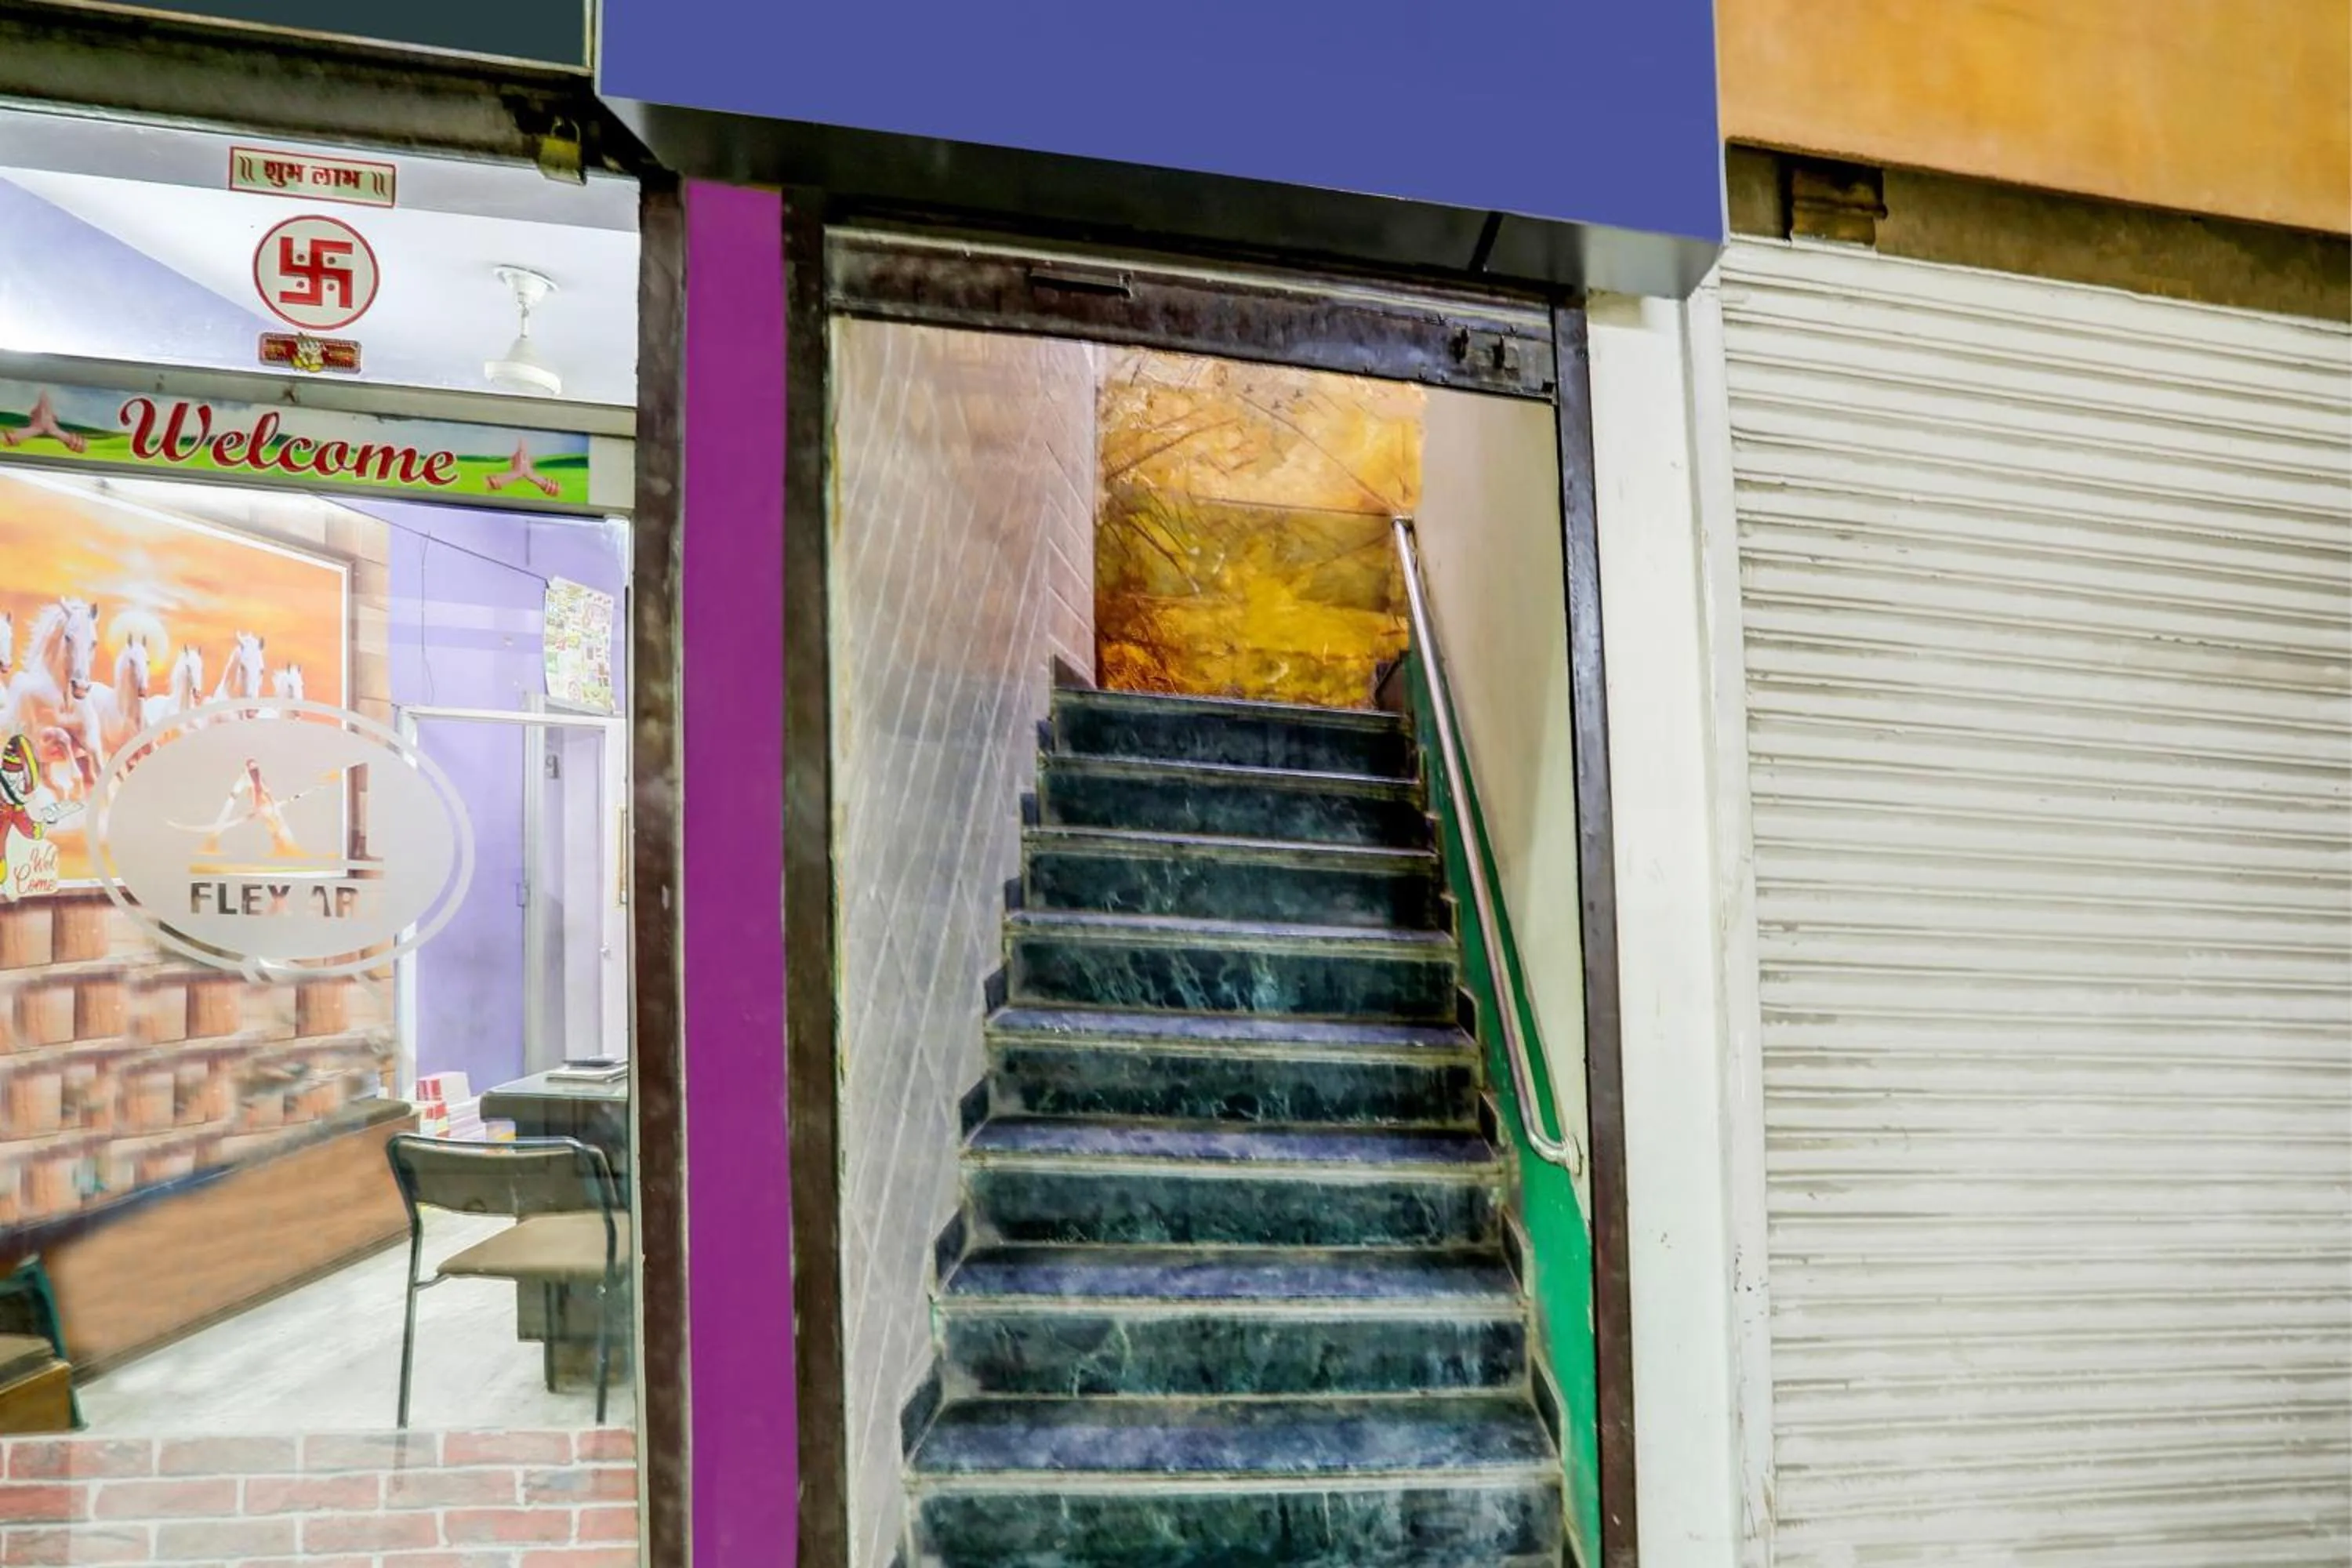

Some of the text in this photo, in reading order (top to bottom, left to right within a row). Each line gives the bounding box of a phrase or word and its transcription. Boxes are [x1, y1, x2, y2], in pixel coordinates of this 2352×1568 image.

[263, 159, 306, 187] शुभ
[310, 165, 362, 189] लाभ
[119, 397, 459, 485] Welcome
[190, 881, 293, 917] FLEX
